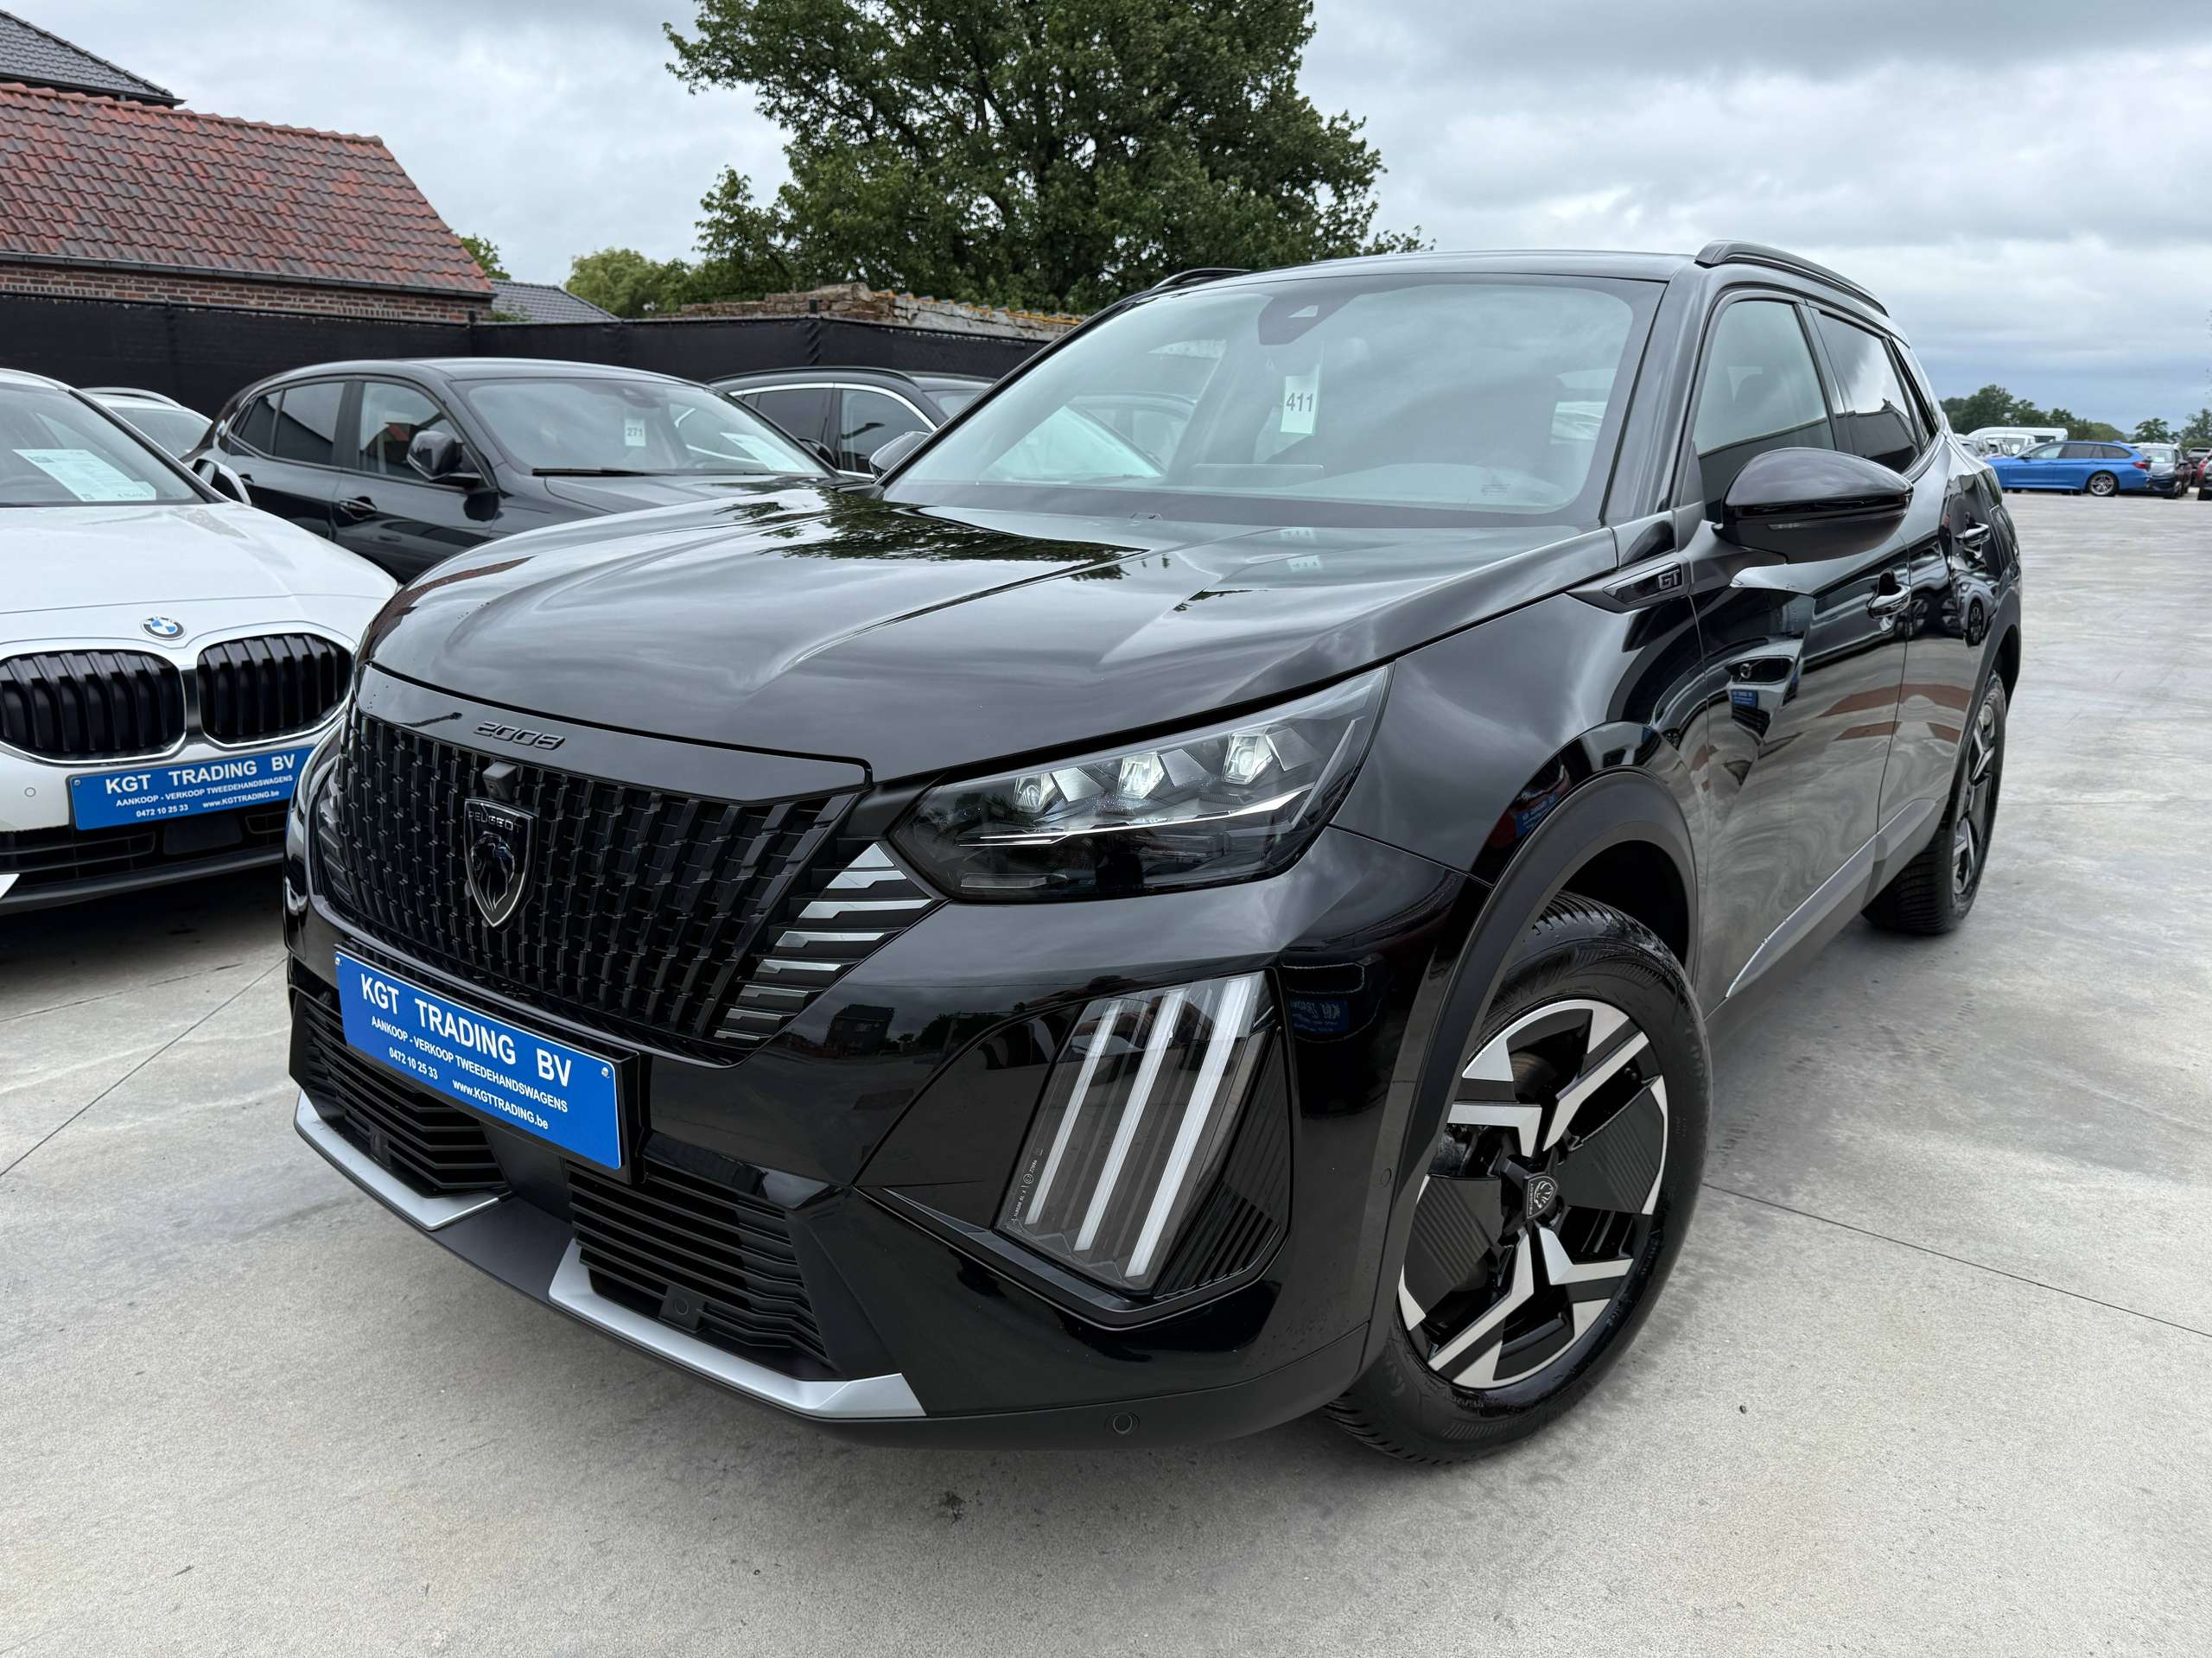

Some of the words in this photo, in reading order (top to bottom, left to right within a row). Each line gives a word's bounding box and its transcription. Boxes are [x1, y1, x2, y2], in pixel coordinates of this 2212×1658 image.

[1285, 392, 1313, 412] 411
[627, 428, 643, 436] 271
[1658, 569, 1681, 590] GT
[474, 721, 566, 751] 2008
[105, 774, 151, 794] KGT
[168, 760, 257, 787] TRADING
[270, 753, 296, 772] BV
[116, 794, 159, 807] AANKOOP
[165, 788, 206, 801] VERKOOP
[207, 774, 293, 795] TWEEDEHANDSWAGENS
[202, 790, 280, 809] www.KGTTRADING.be
[136, 808, 156, 818] 0472
[157, 806, 167, 815] 10
[168, 805, 178, 814] 25
[179, 804, 188, 812] 33
[361, 973, 399, 1015] KGT
[415, 998, 517, 1065] TRADING
[536, 1047, 572, 1087] BV
[372, 1015, 409, 1042] AANKOOP
[413, 1036, 454, 1063] VERKOOP
[455, 1055, 568, 1113] TWEEDEHANDSWAGENS
[389, 1046, 406, 1064] 0472
[407, 1056, 416, 1070] 10
[417, 1061, 427, 1075] 25
[428, 1066, 438, 1080] 33
[453, 1079, 549, 1130] www.KGTTRADING.be
